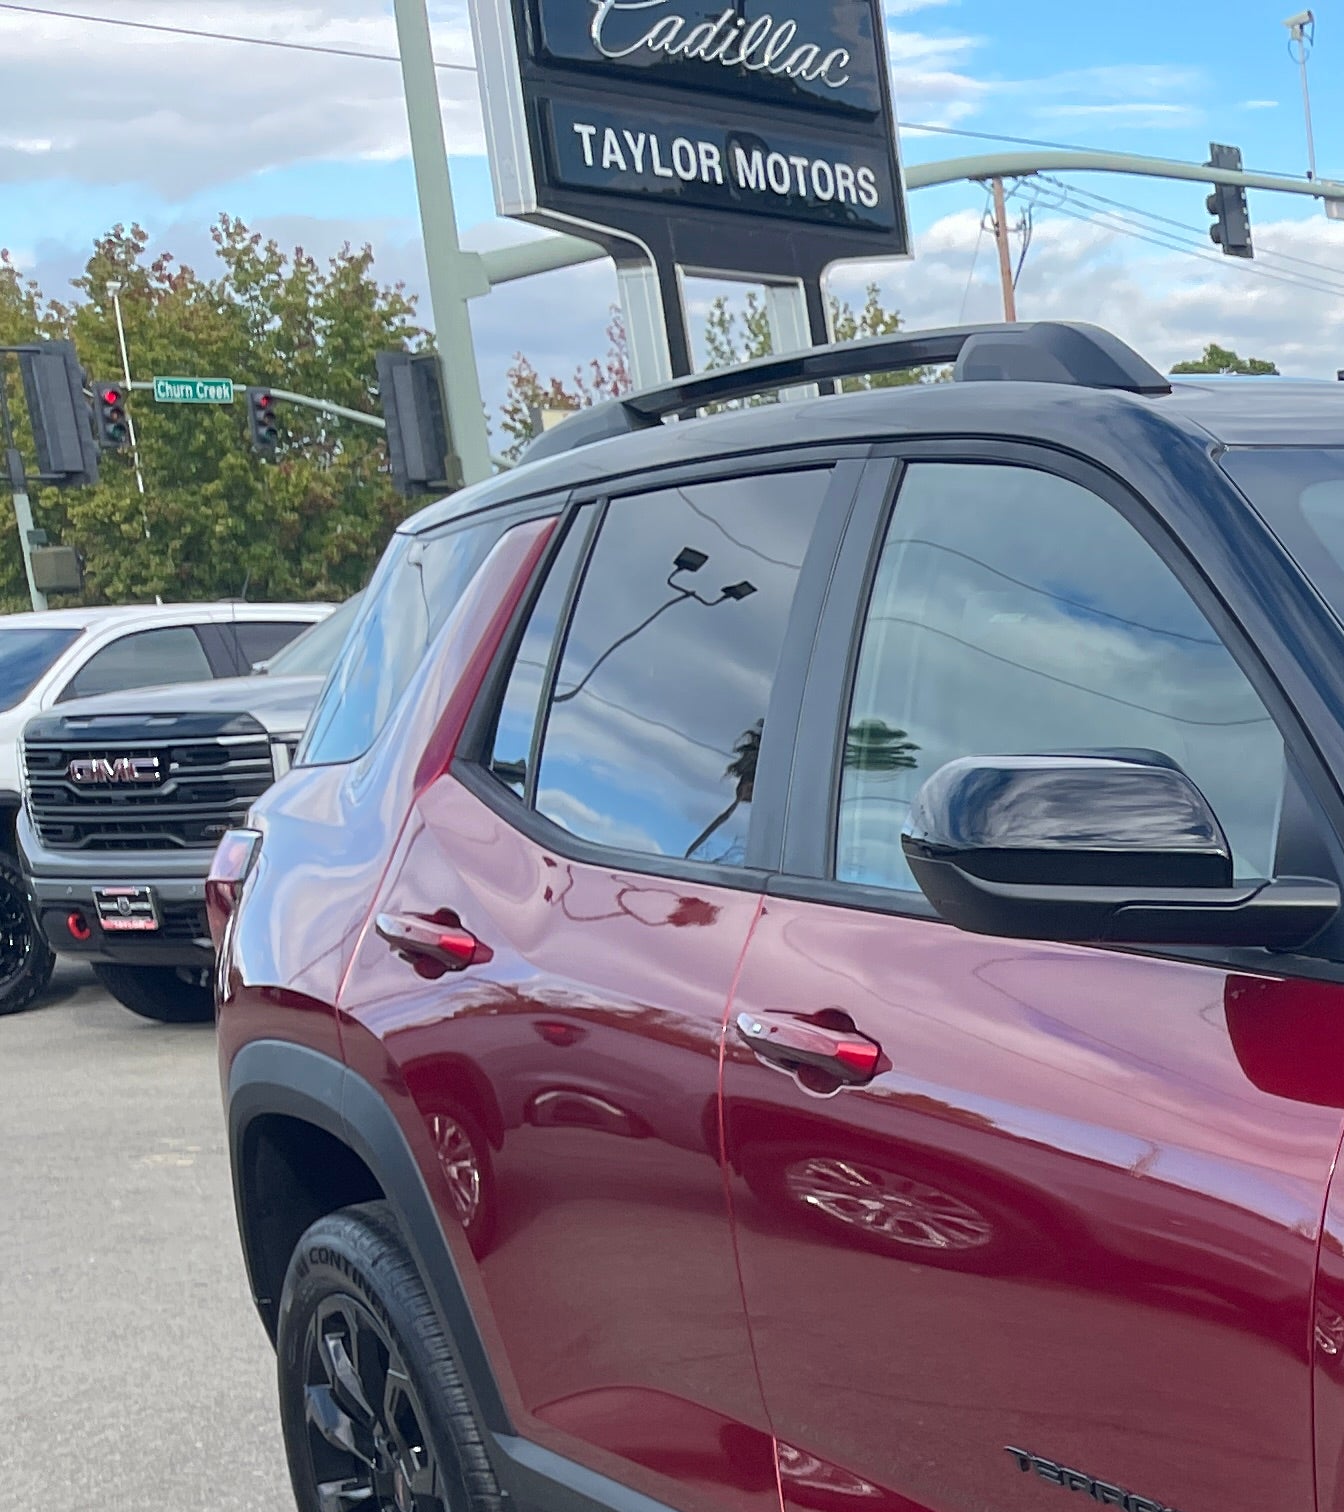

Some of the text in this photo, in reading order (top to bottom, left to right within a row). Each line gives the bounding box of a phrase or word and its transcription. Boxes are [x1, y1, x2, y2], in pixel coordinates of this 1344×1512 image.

[591, 0, 850, 88] Cadillac
[573, 122, 879, 208] TAYLOR MOTORS
[157, 381, 230, 399] Churn Creek
[70, 757, 160, 784] GMC
